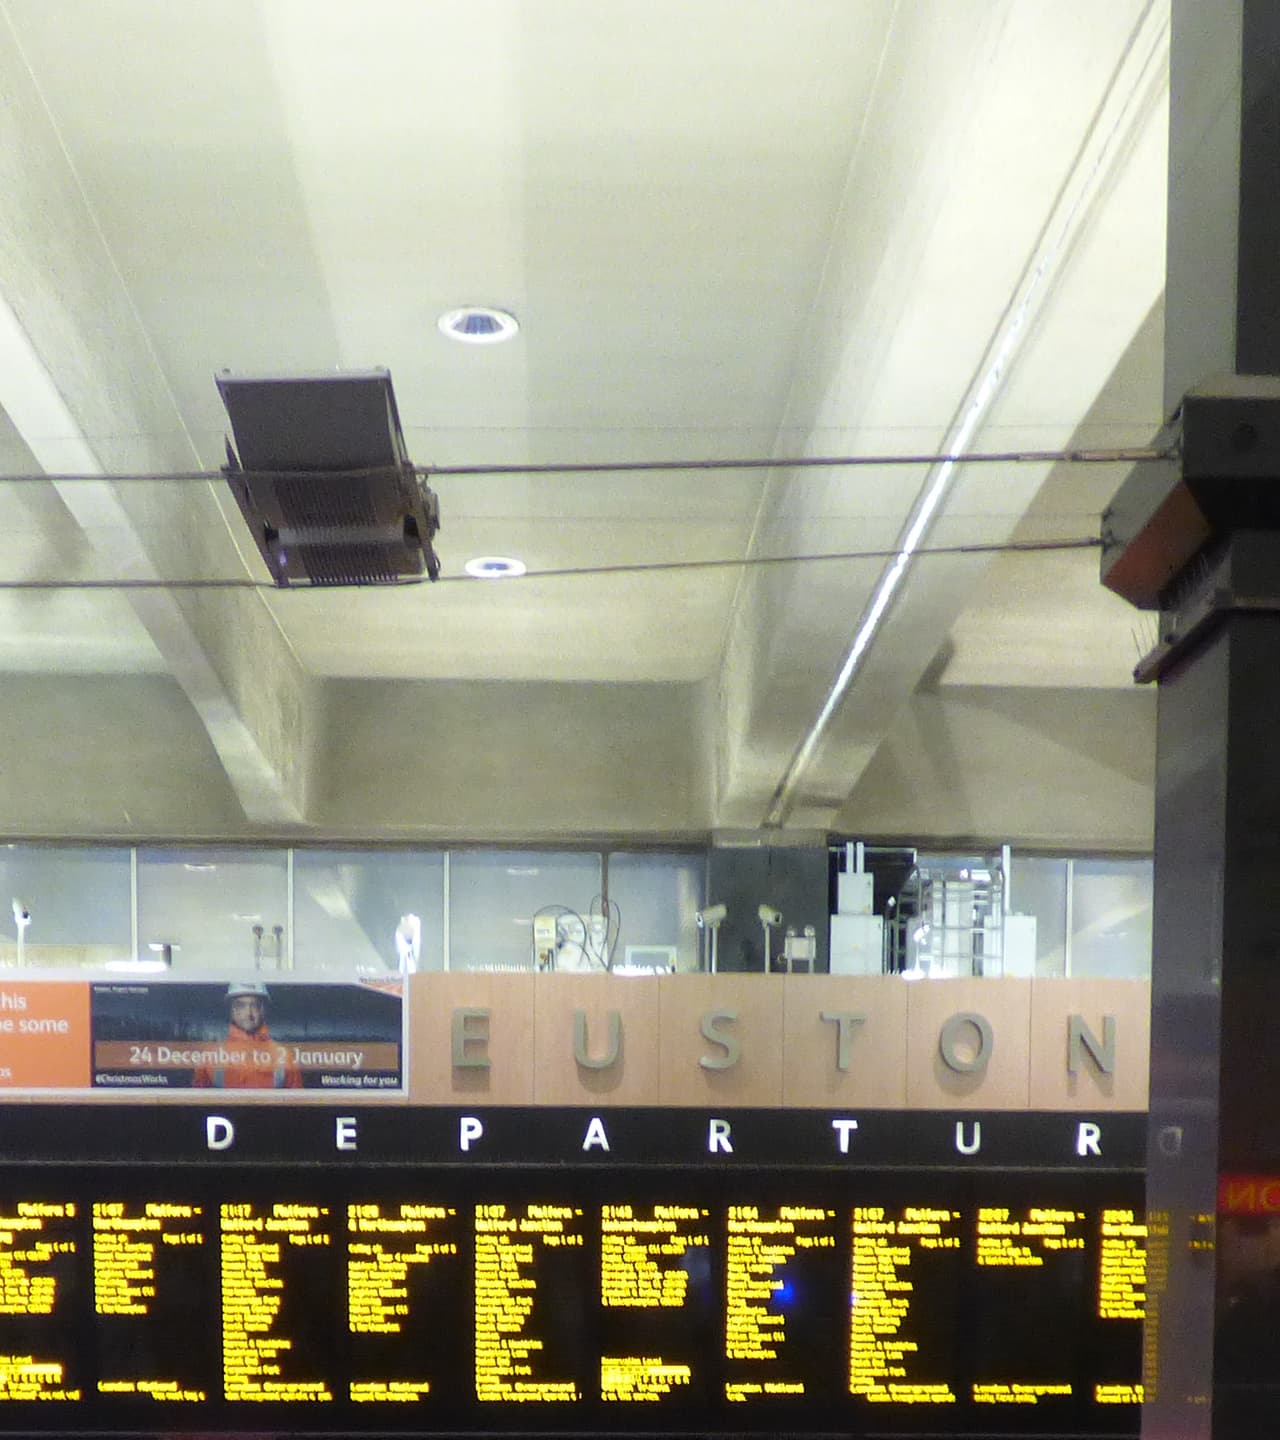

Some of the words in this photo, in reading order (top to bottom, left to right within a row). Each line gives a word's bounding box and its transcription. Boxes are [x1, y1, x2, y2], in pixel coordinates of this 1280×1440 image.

[19, 1019, 69, 1033] some
[451, 1008, 1116, 1076] EUSTON
[130, 1046, 152, 1063] 24
[158, 1046, 249, 1064] December
[253, 1048, 271, 1064] to
[277, 1046, 287, 1064] 2
[292, 1047, 364, 1069] January
[322, 1075, 361, 1086] Working
[363, 1075, 377, 1085] for
[379, 1077, 399, 1087] you
